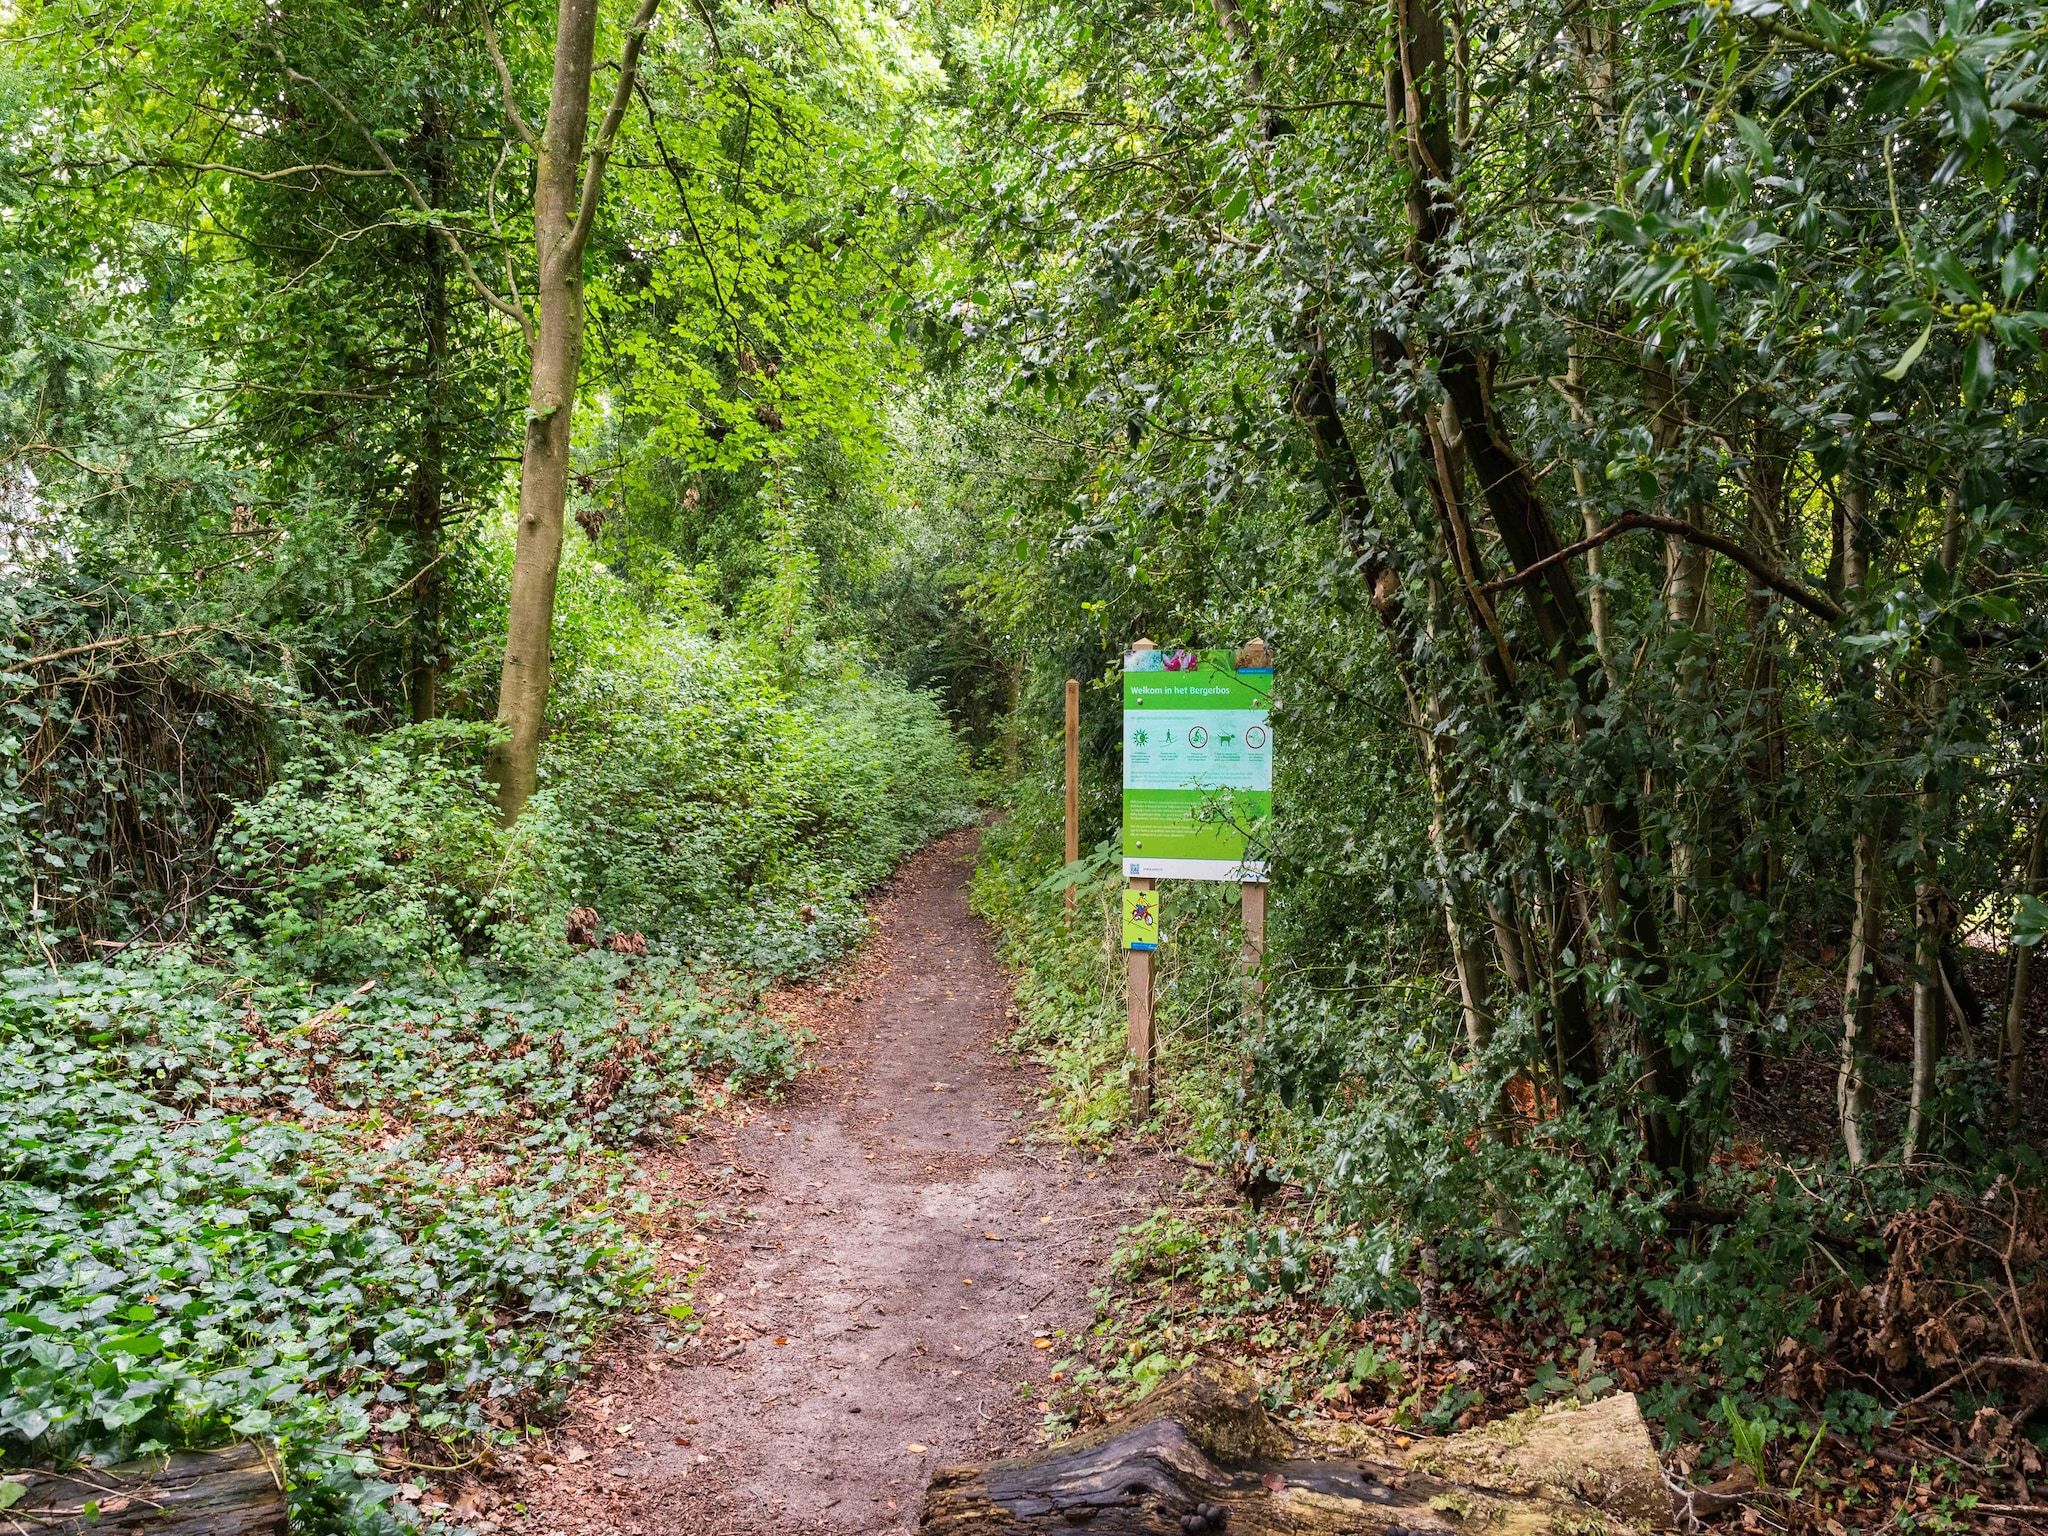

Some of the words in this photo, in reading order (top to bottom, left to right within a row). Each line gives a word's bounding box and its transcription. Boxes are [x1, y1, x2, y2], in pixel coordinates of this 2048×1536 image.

[1131, 686, 1162, 694] Welkom
[1165, 686, 1172, 694] in
[1174, 686, 1188, 694] het
[1190, 686, 1230, 696] Bergerbos
